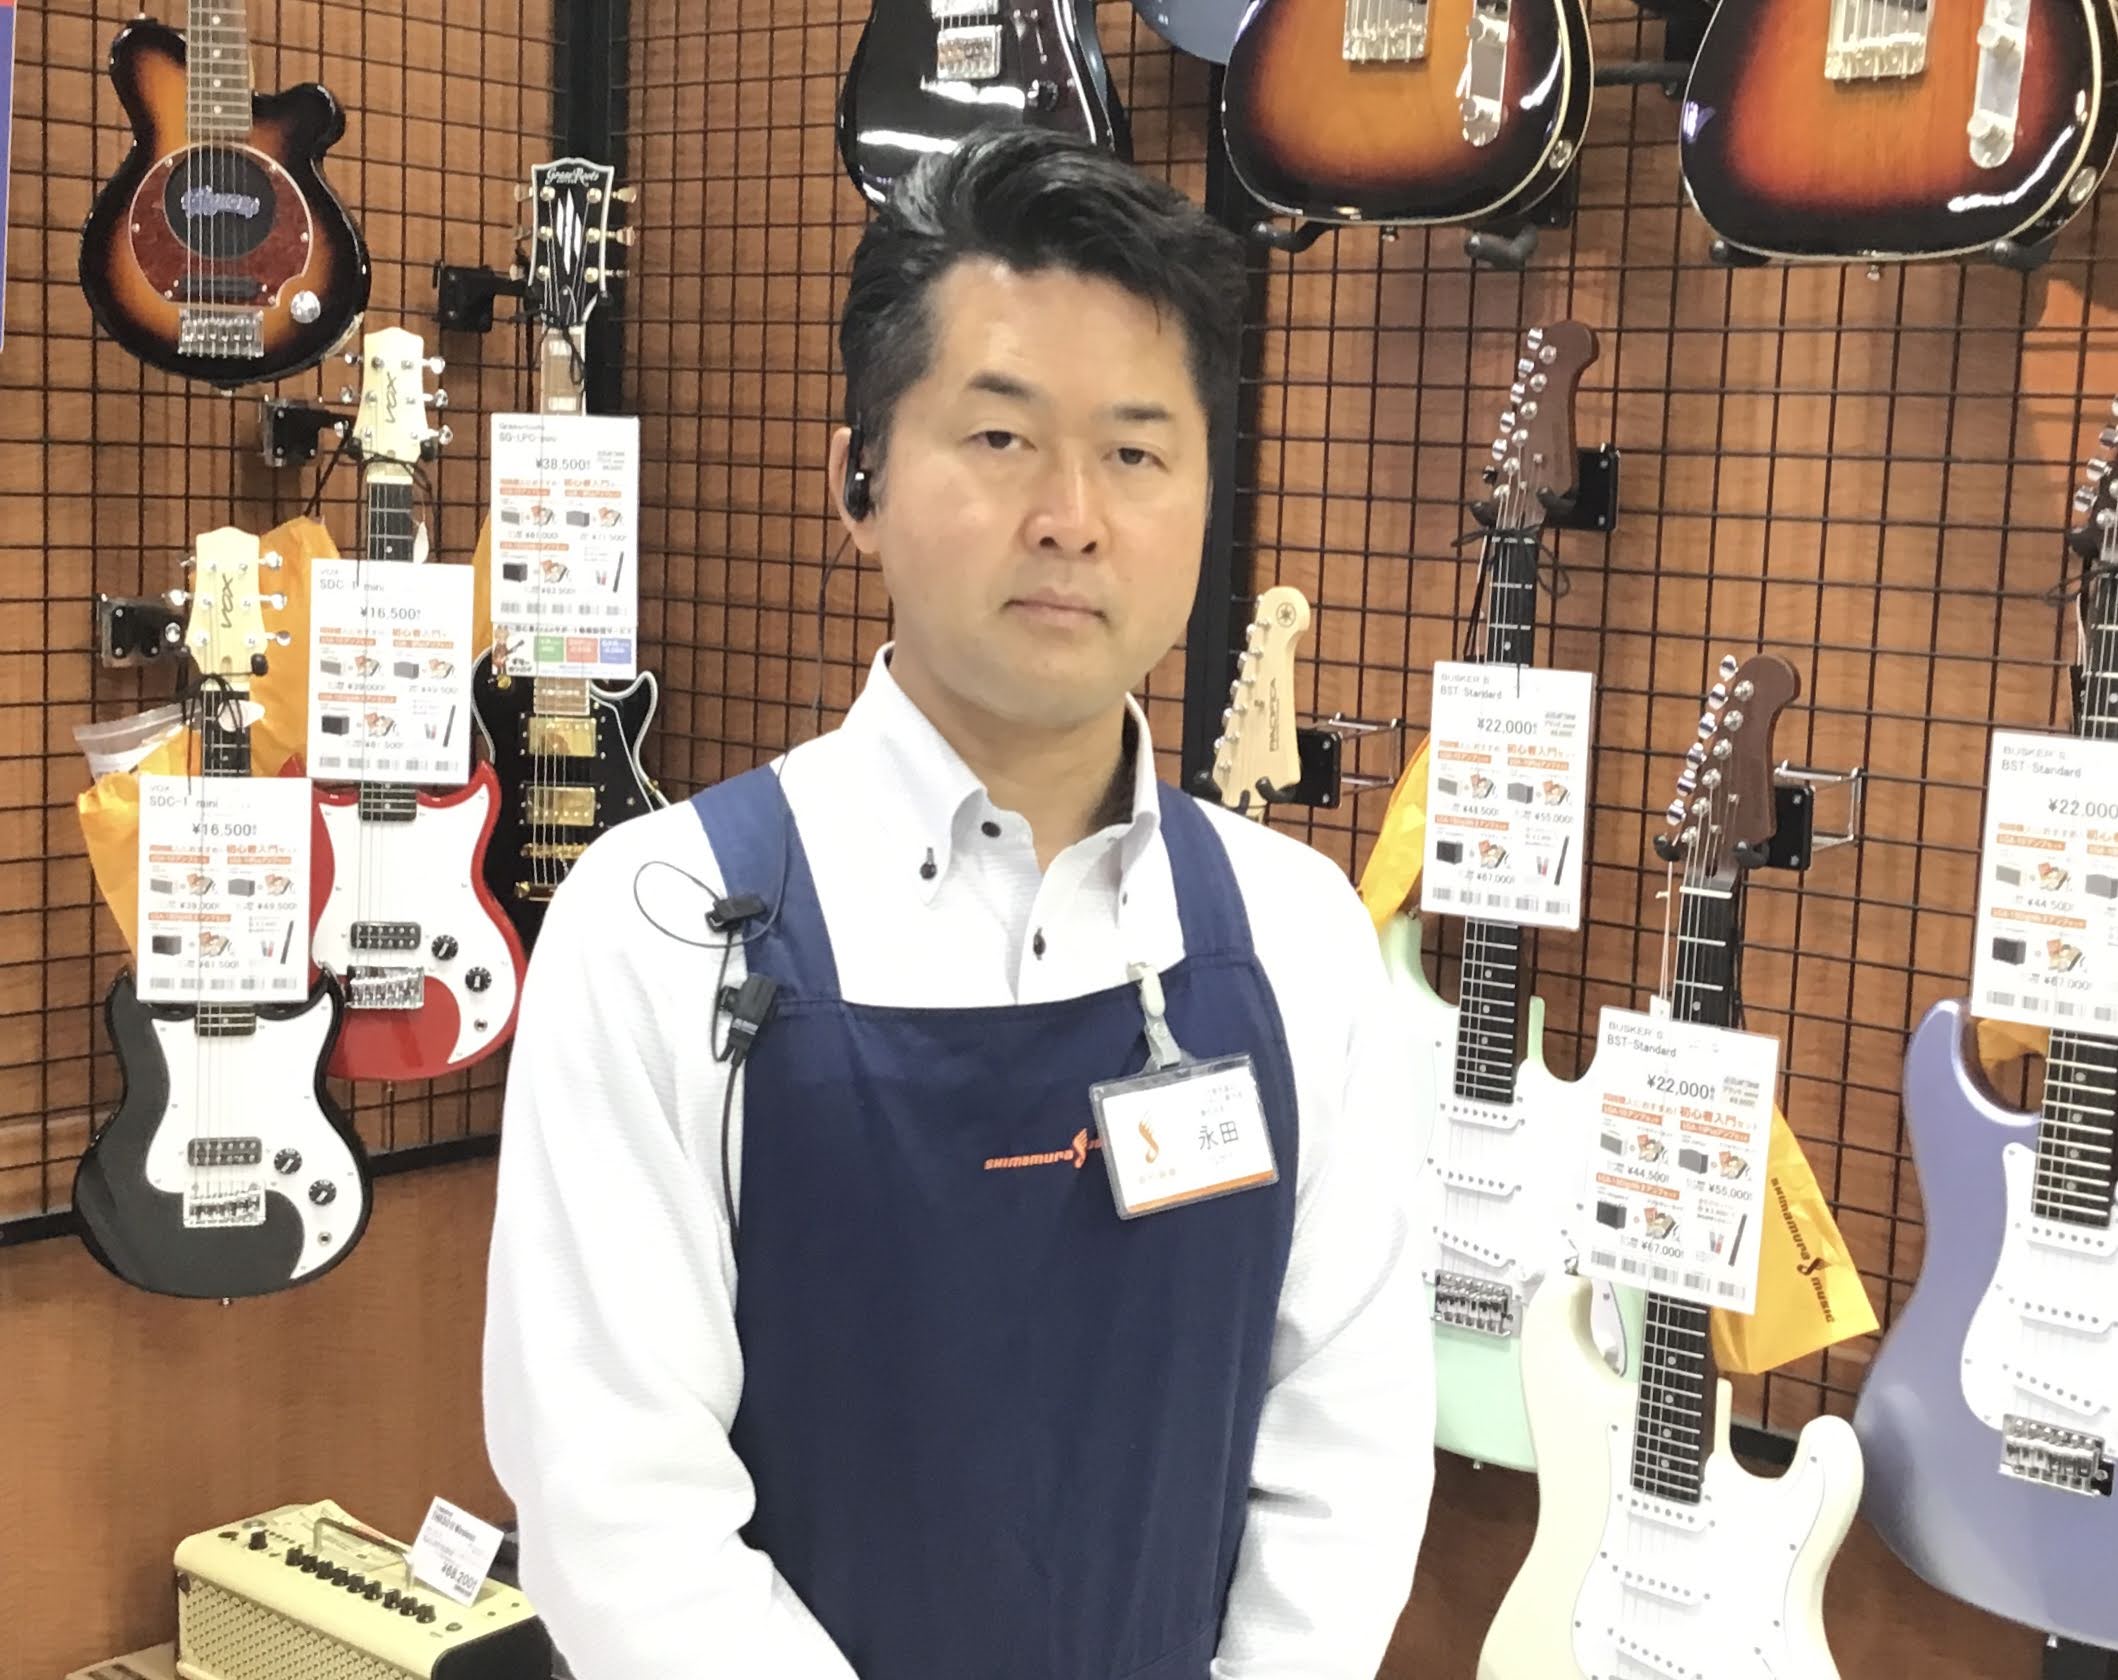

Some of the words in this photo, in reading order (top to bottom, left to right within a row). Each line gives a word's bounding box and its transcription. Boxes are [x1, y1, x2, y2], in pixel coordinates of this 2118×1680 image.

[1477, 717, 1532, 735] ¥22,000
[192, 823, 252, 836] ¥16,500
[1647, 1074, 1709, 1100] ¥22,000
[1199, 1121, 1239, 1151] 永田
